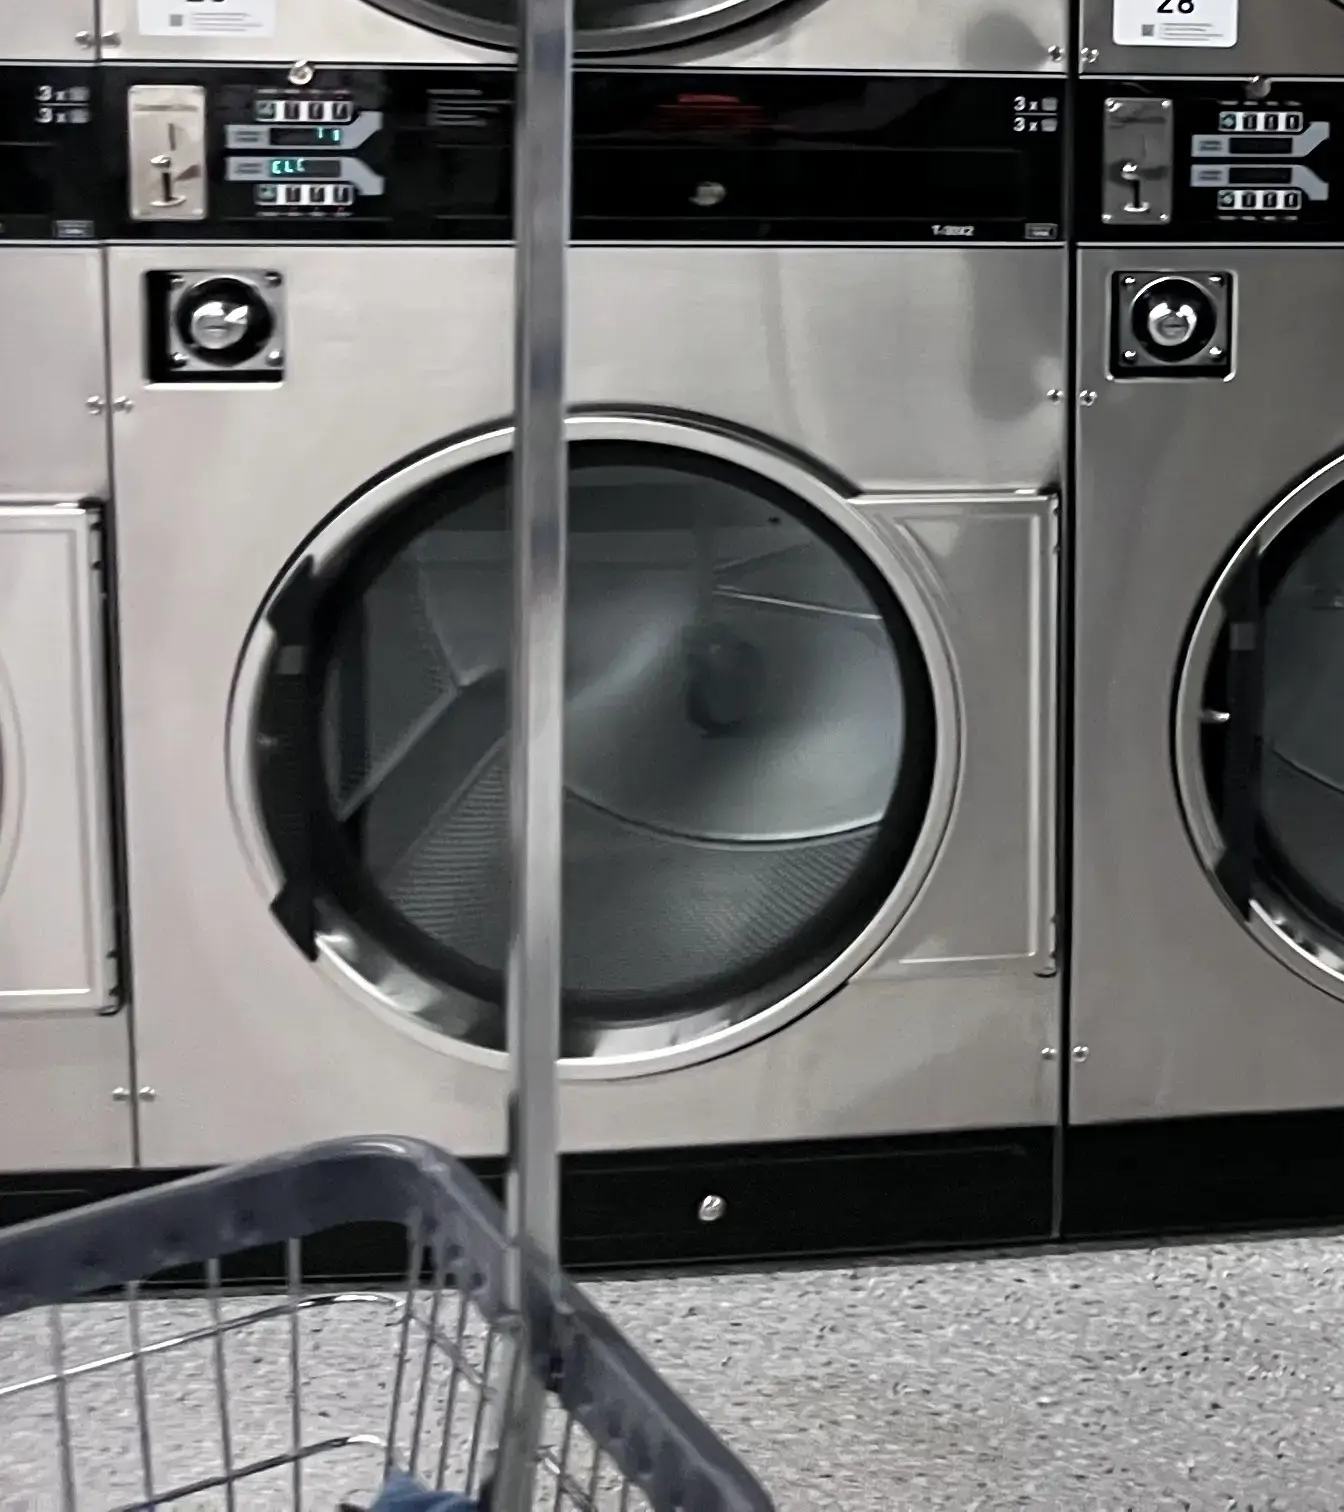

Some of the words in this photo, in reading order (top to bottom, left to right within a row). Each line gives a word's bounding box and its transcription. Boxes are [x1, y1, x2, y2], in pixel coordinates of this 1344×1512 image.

[35, 85, 53, 101] 3
[1013, 96, 1026, 112] 3
[35, 107, 53, 123] 3
[1013, 117, 1026, 133] 3
